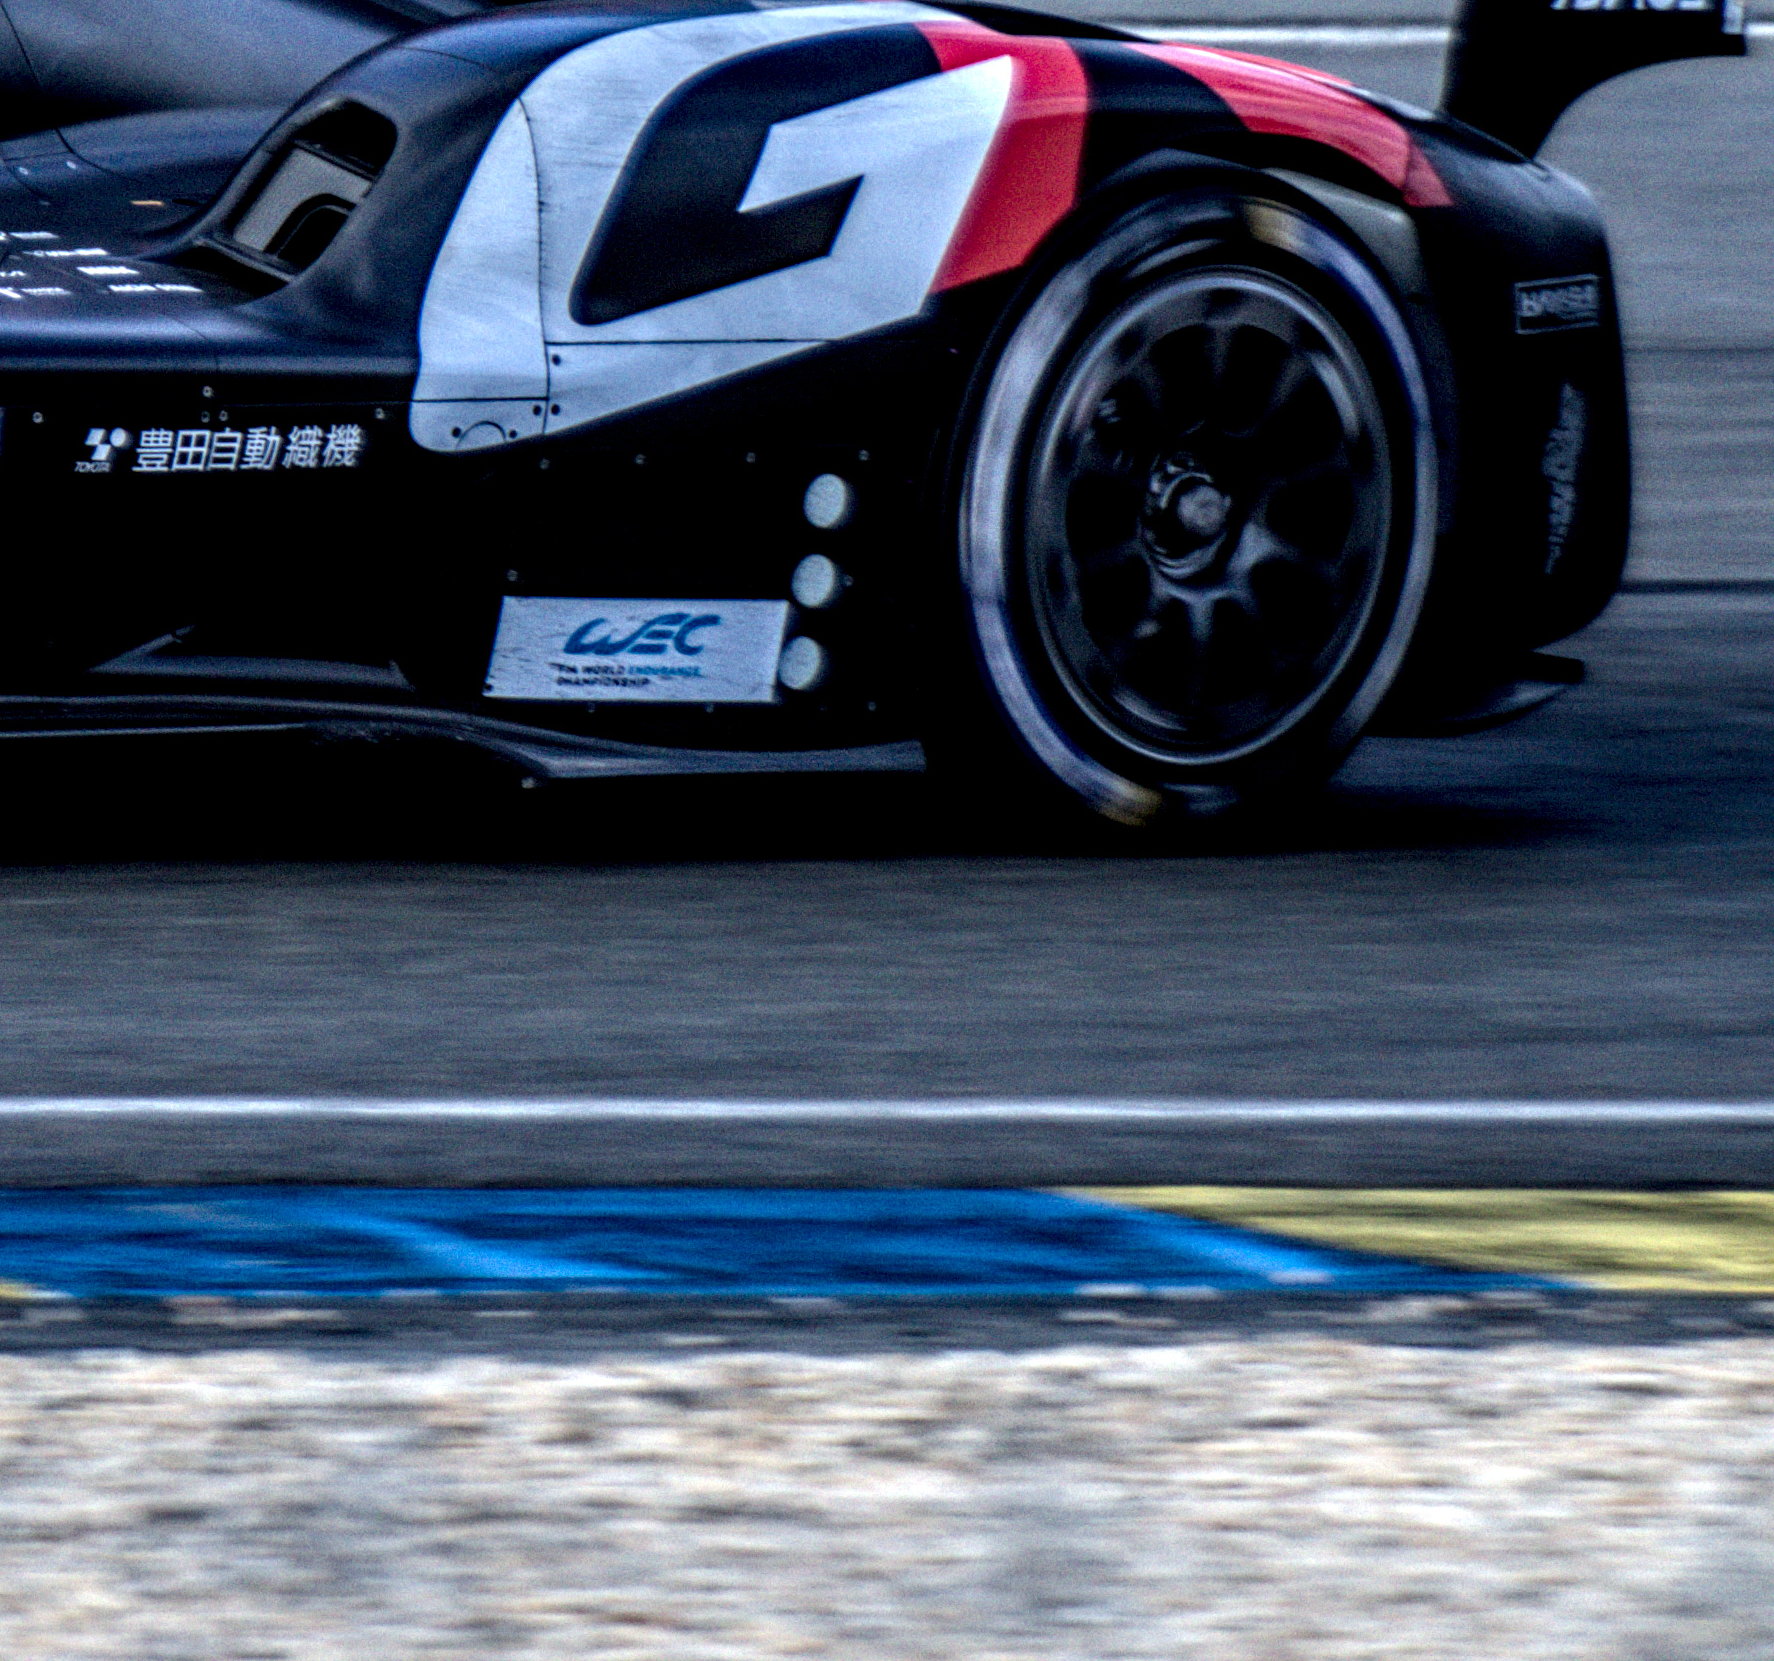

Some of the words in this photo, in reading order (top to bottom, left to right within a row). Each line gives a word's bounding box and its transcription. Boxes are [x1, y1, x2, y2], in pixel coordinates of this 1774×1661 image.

[132, 424, 363, 472] 豊田自動織機
[563, 612, 721, 656] WEC
